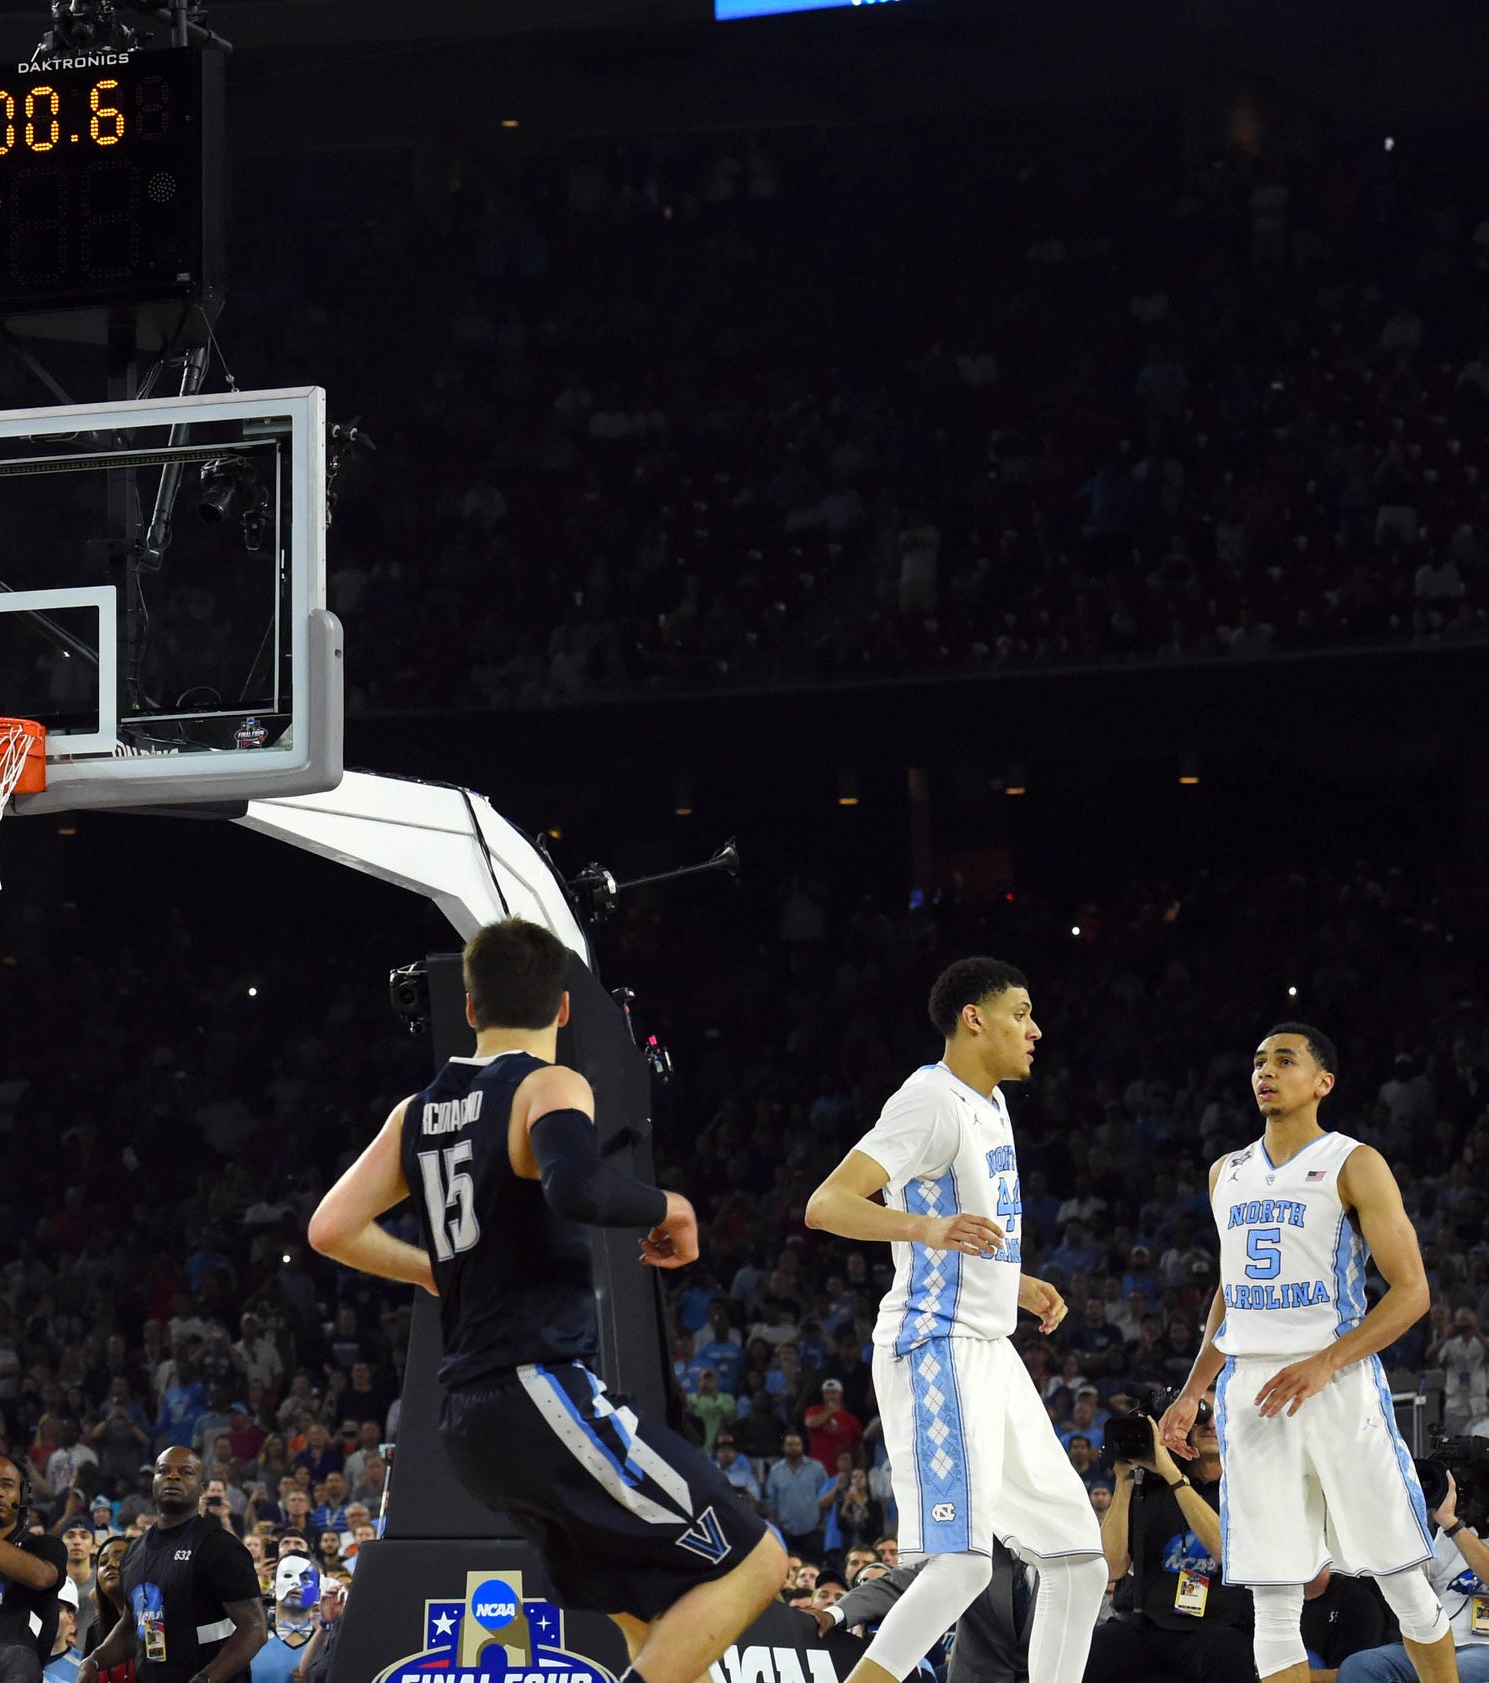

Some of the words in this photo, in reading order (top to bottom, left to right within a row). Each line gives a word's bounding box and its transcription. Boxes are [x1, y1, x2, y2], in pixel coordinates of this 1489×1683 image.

[18, 52, 130, 74] DAKTRONICS
[417, 1139, 481, 1262] 15
[1228, 1199, 1307, 1230] NORTH
[1244, 1228, 1282, 1280] 5
[1224, 1280, 1331, 1311] AROLINA
[174, 1550, 192, 1560] 632
[475, 1603, 516, 1618] NCAA
